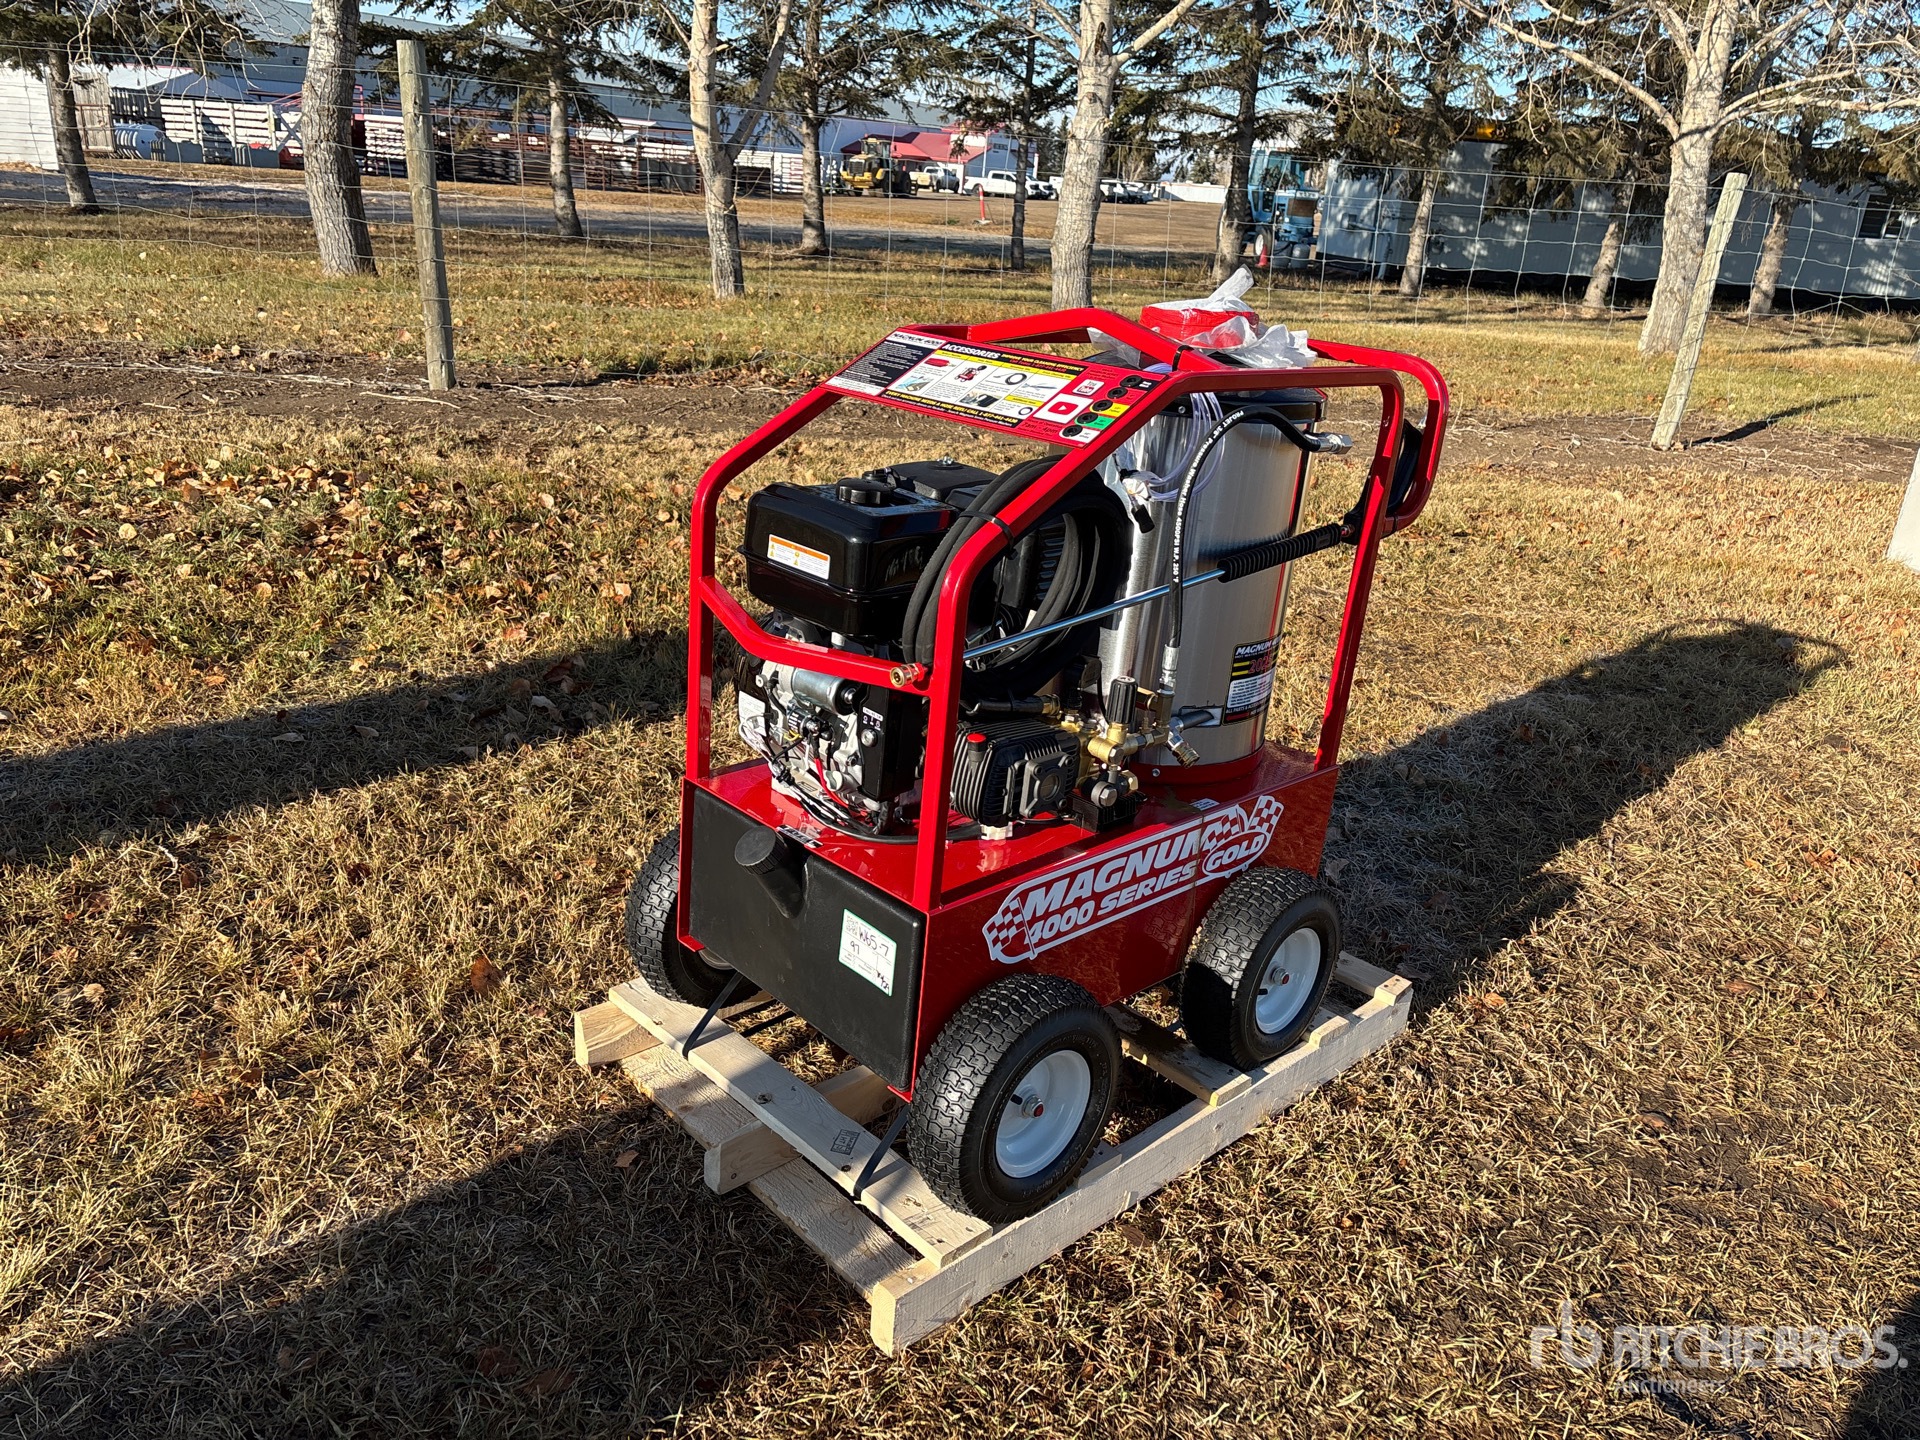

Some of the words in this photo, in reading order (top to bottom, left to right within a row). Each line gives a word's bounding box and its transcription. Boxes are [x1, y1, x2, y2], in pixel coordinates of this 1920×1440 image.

[942, 344, 1001, 359] ACCESSORIES
[1177, 497, 1186, 516] Hose
[1235, 640, 1272, 655] MAGNUM
[1208, 834, 1265, 869] GOLD
[1023, 819, 1224, 920] MAGNUM
[1025, 899, 1096, 945] 4000
[1096, 859, 1198, 916] SERIES
